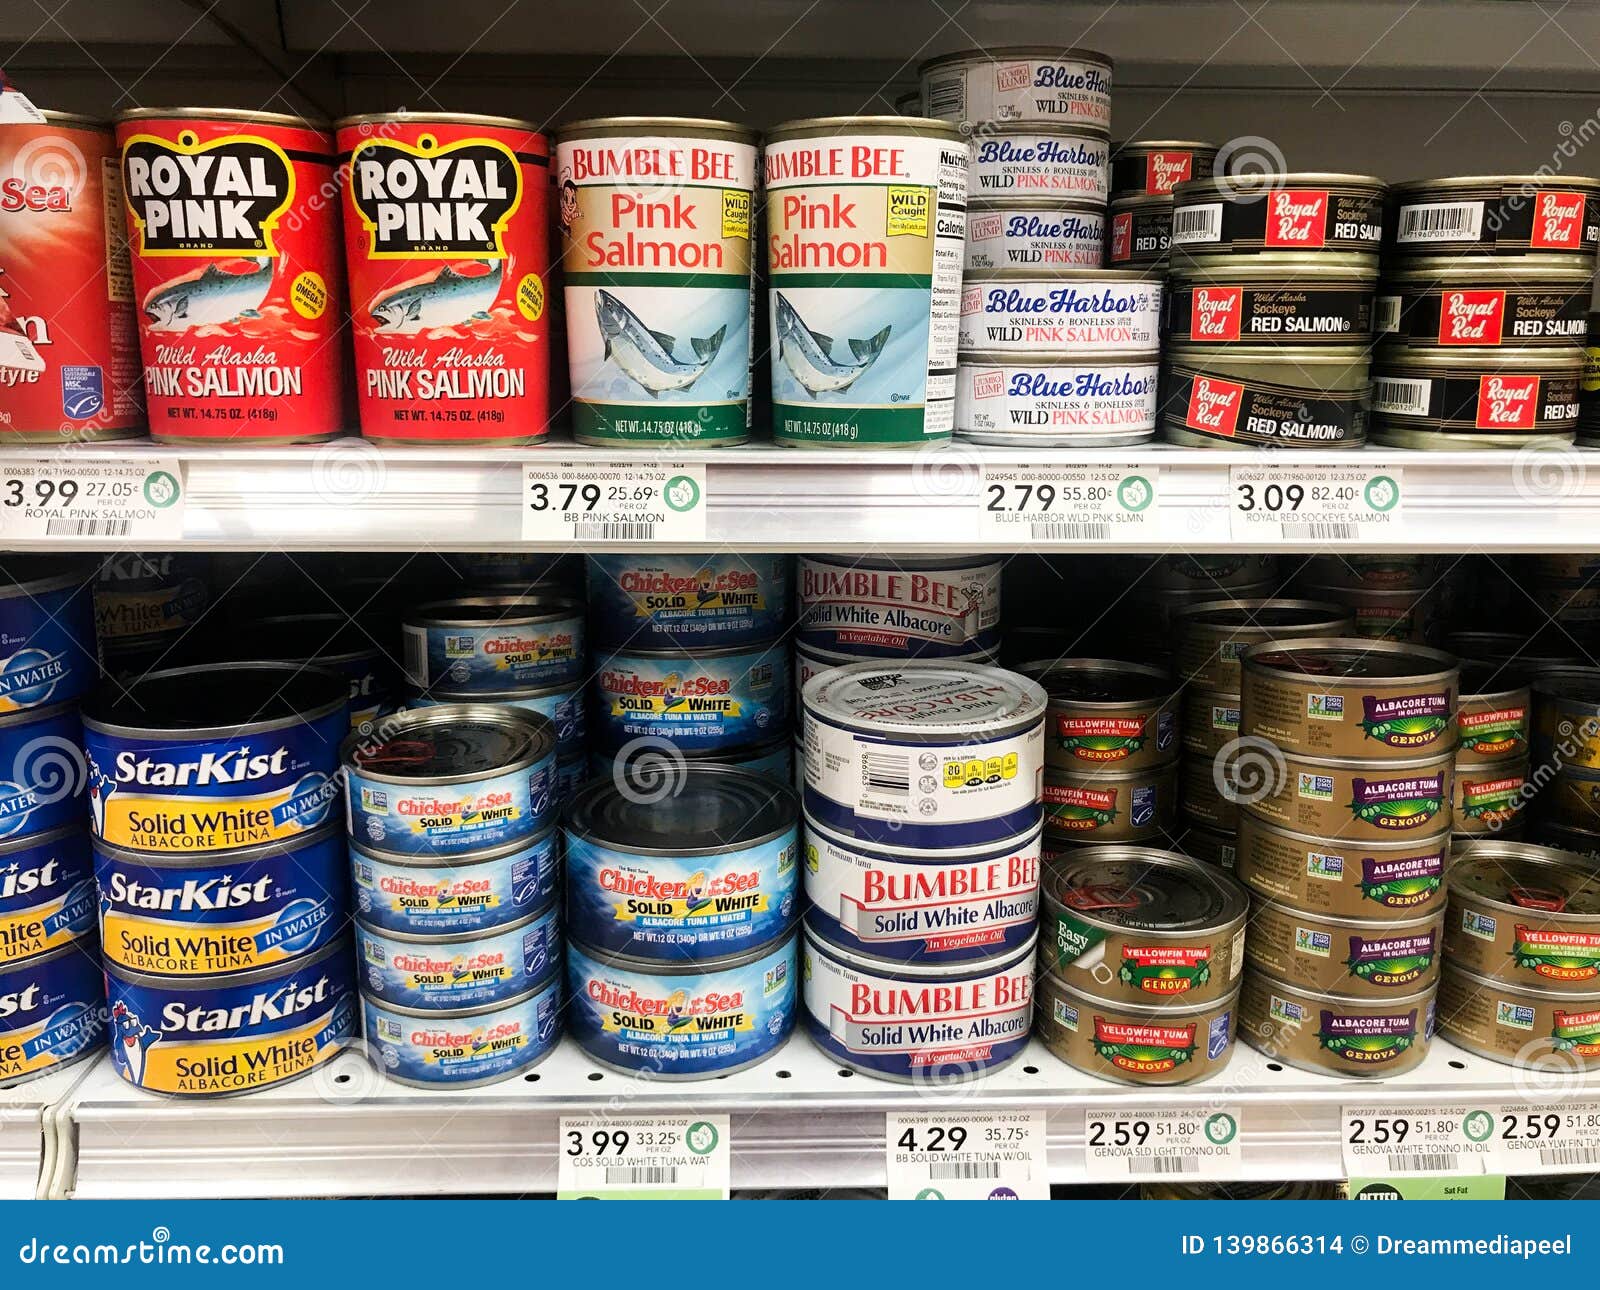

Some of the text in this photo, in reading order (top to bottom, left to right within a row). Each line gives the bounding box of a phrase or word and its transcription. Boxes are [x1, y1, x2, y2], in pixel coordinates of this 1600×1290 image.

[1034, 66, 1085, 88] Blue
[128, 155, 276, 197] ROYAL
[361, 159, 507, 200] ROYAL
[1, 178, 72, 212] Sea
[891, 195, 926, 206] WILD
[1542, 194, 1580, 220] Royal
[144, 200, 257, 239] PINK
[377, 203, 489, 241] PINK
[611, 193, 697, 229] Pink
[784, 194, 856, 229] Pink
[892, 206, 926, 217] Caught
[1545, 219, 1570, 242] Red
[587, 232, 723, 268] Salmon
[771, 234, 887, 268] Salmon
[1009, 250, 1071, 263] WILD PINK
[985, 289, 1046, 313] Blue
[1050, 289, 1138, 312] Harbor
[1198, 290, 1236, 317] Royal
[1254, 304, 1296, 315] Sockeye
[987, 328, 1150, 341] WILD PINK SALMON WATER
[1252, 317, 1343, 332] RED SALMON
[1514, 320, 1584, 336] RED SALMON
[156, 344, 278, 366] Wild Alaska
[367, 368, 524, 399] PINK SALMON
[394, 410, 504, 423] NET WT. 14.75 OZ. (418g)
[1010, 411, 1145, 425] WILD PINK SALMON
[1198, 402, 1225, 426] Red
[1544, 406, 1564, 420] RED
[5, 480, 78, 507] 3.99
[530, 484, 601, 511] 3.79
[987, 485, 1055, 511] 2.79
[1238, 484, 1304, 511] 3.09
[25, 509, 156, 519] ROYAL PINK SALMON
[564, 513, 665, 522] BB PINK SALMON
[995, 513, 1143, 522] BLUE HARBOR WLD PNK SLMN
[1247, 513, 1390, 522] ROYAL RED SOCKEYE SALMON
[836, 607, 951, 636] White Albacore
[849, 634, 890, 645] Vegetable
[891, 636, 905, 645] Oil
[14, 661, 62, 687] WATER
[1064, 720, 1140, 729] YELLOWFIN TUNA
[115, 746, 288, 786] StarKist
[1086, 792, 1110, 802] TUNA
[1365, 780, 1438, 795] ALBACORE TUNA
[129, 809, 270, 834] Solid White
[600, 869, 760, 900] Chicken Sea
[864, 857, 1037, 903] BUMBLE BEE
[110, 875, 273, 911] StarKist
[400, 895, 491, 907] SOLID WHITE
[265, 907, 327, 945] IN WATER
[643, 918, 684, 926] ALBACORE
[687, 917, 708, 925] TUNA
[720, 912, 746, 922] WATER
[875, 899, 1034, 933] Solid White Albacore
[1058, 921, 1089, 949] Easy
[1058, 938, 1080, 956] Open
[1525, 933, 1585, 943] YELLOWFIN
[1127, 949, 1207, 957] YELLOWFIN TUNA
[1542, 967, 1594, 977] GENOVA
[1144, 980, 1188, 989] GENOVA
[588, 980, 743, 1016] Chicken Sea
[1331, 1018, 1409, 1027] ALBACORE TUNA
[176, 1038, 314, 1080] Solid White
[898, 1127, 967, 1152] 4.29
[1089, 1121, 1150, 1146] 2.59
[1349, 1119, 1409, 1143] 2.59
[1502, 1115, 1560, 1140] 2.59
[567, 1130, 629, 1156] 3.99
[1095, 1146, 1230, 1157] GENOVA SLD LGHT TONNO OIL
[1353, 1144, 1490, 1155] GENOVA WHITE TONNO IN OIL
[1507, 1139, 1583, 1149] GENOVA YLW FIN
[573, 1157, 710, 1166] COS SOLID WHITE TUNA WAT
[896, 1152, 1032, 1162] BB SOLID WHITE TUNA W/OIL
